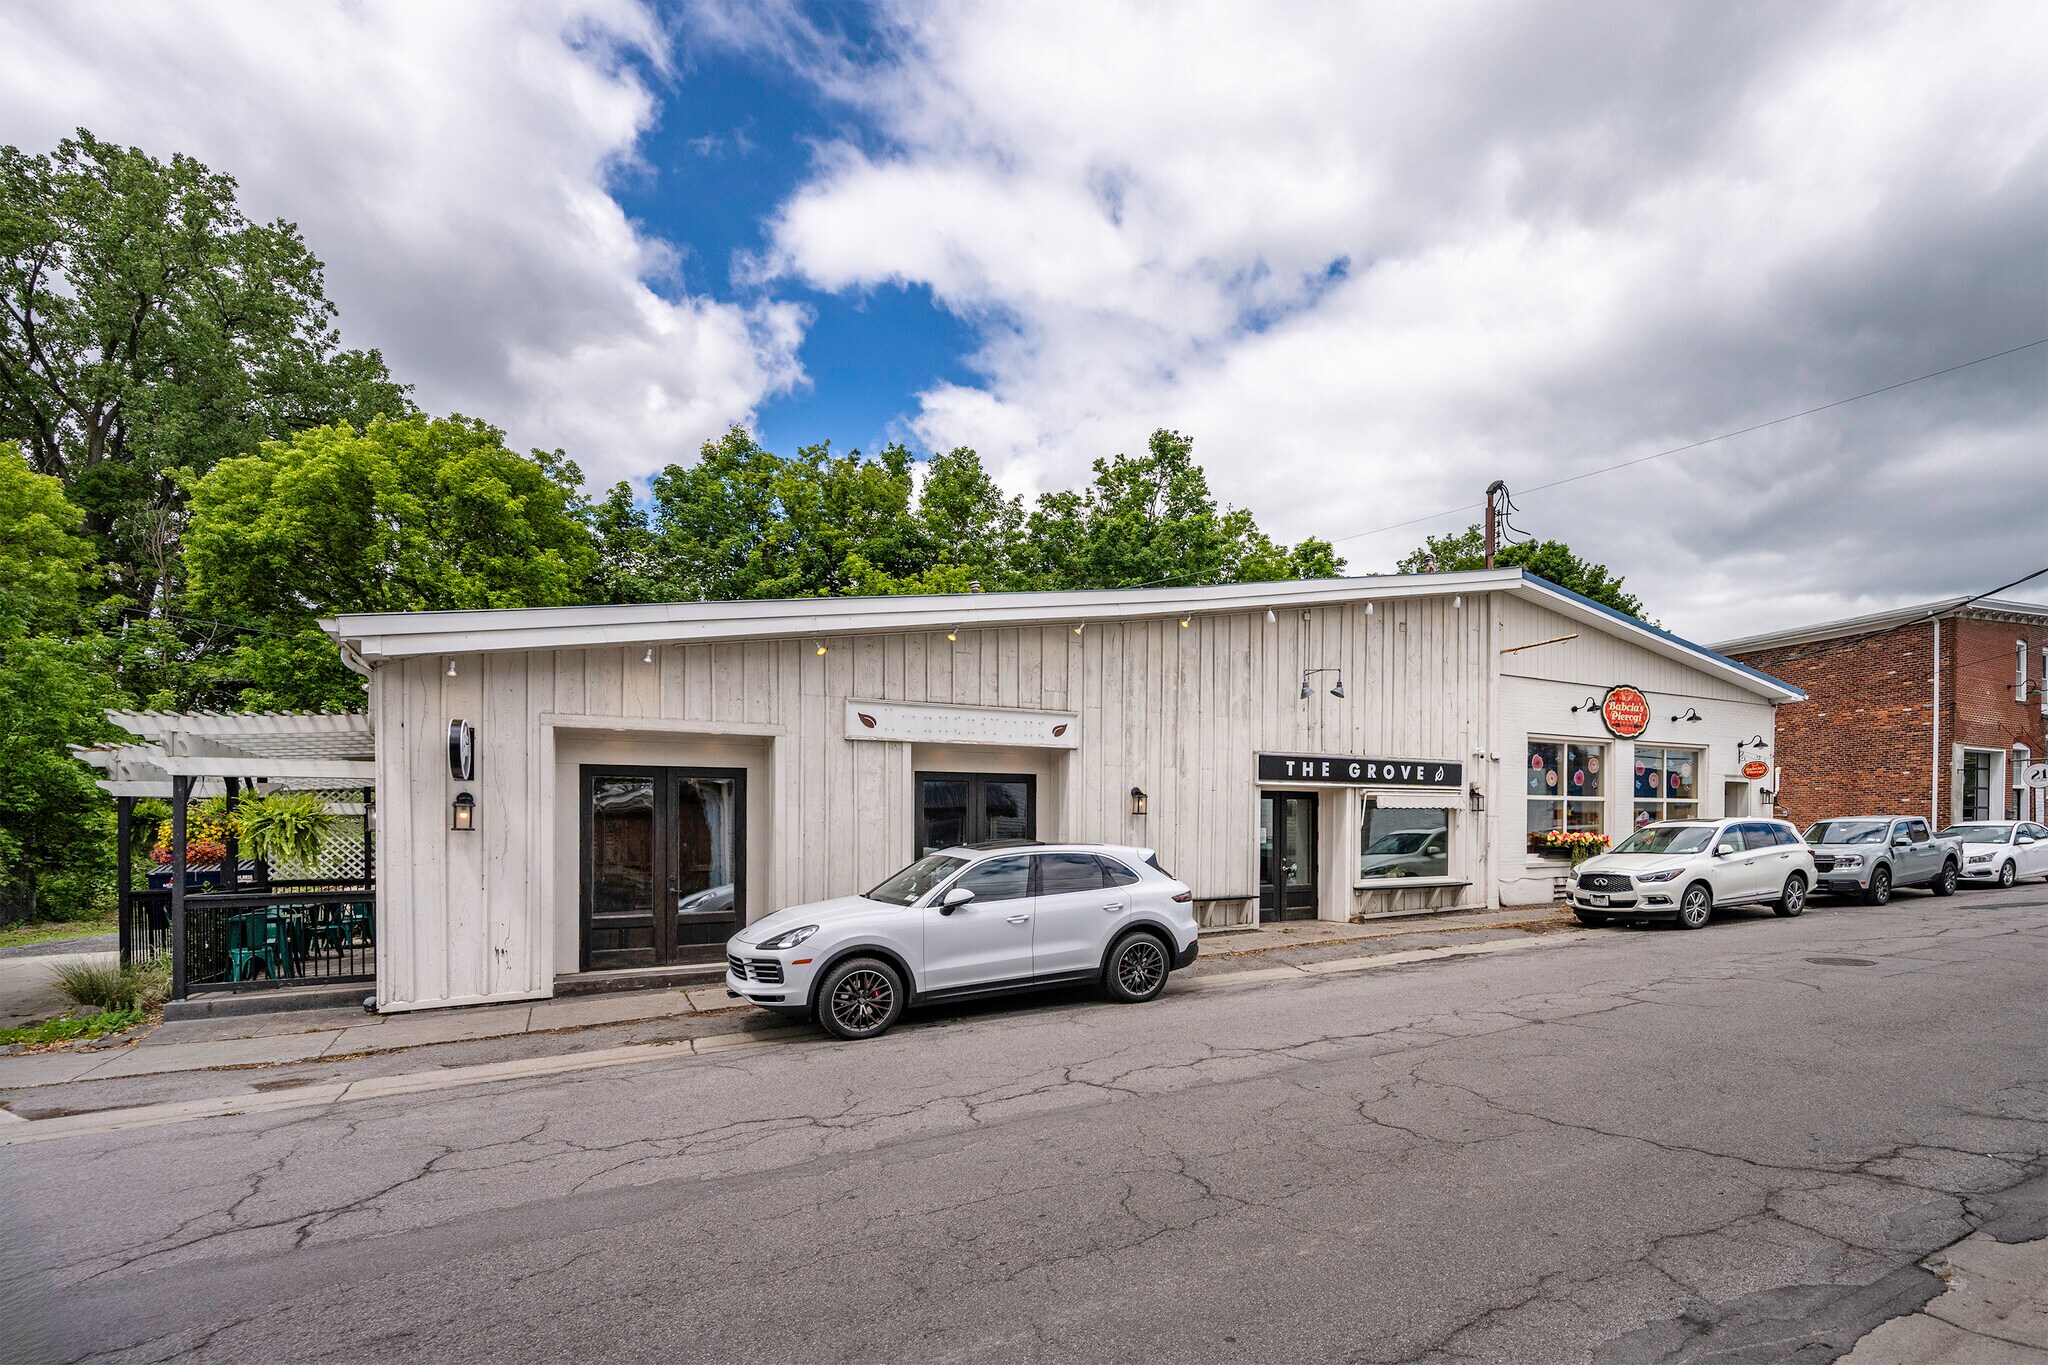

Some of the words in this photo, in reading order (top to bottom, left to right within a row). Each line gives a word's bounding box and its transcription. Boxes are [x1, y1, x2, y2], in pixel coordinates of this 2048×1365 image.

[1608, 702, 1644, 712] Babcia's
[1611, 711, 1642, 723] Pierogi
[1286, 761, 1330, 777] THE
[1348, 763, 1424, 780] GROVE
[2031, 768, 2047, 780] 21
